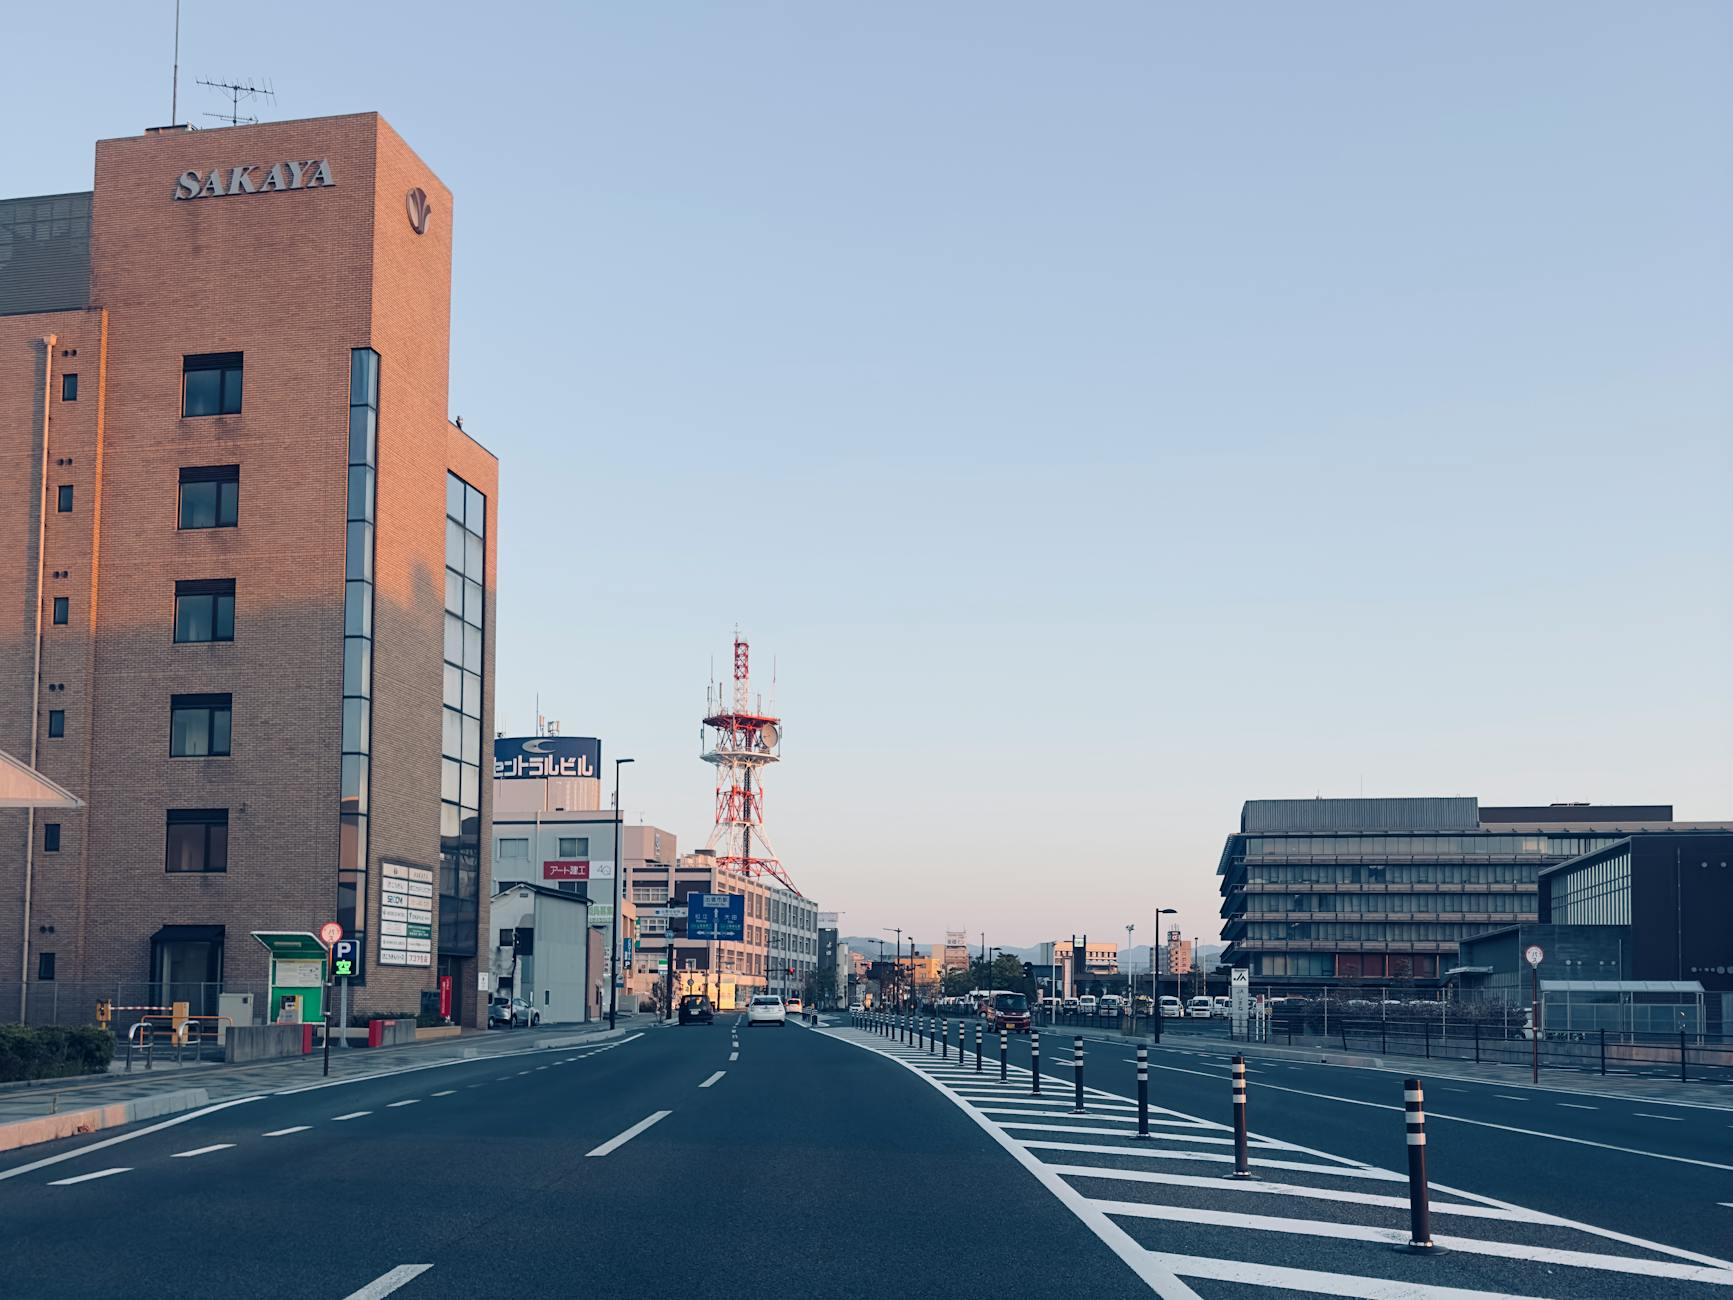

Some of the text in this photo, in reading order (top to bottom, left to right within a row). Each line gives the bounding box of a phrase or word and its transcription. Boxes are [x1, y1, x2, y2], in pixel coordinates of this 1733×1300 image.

[173, 158, 336, 201] SAKAYA
[494, 755, 594, 777] セントラルビル
[337, 943, 351, 958] P
